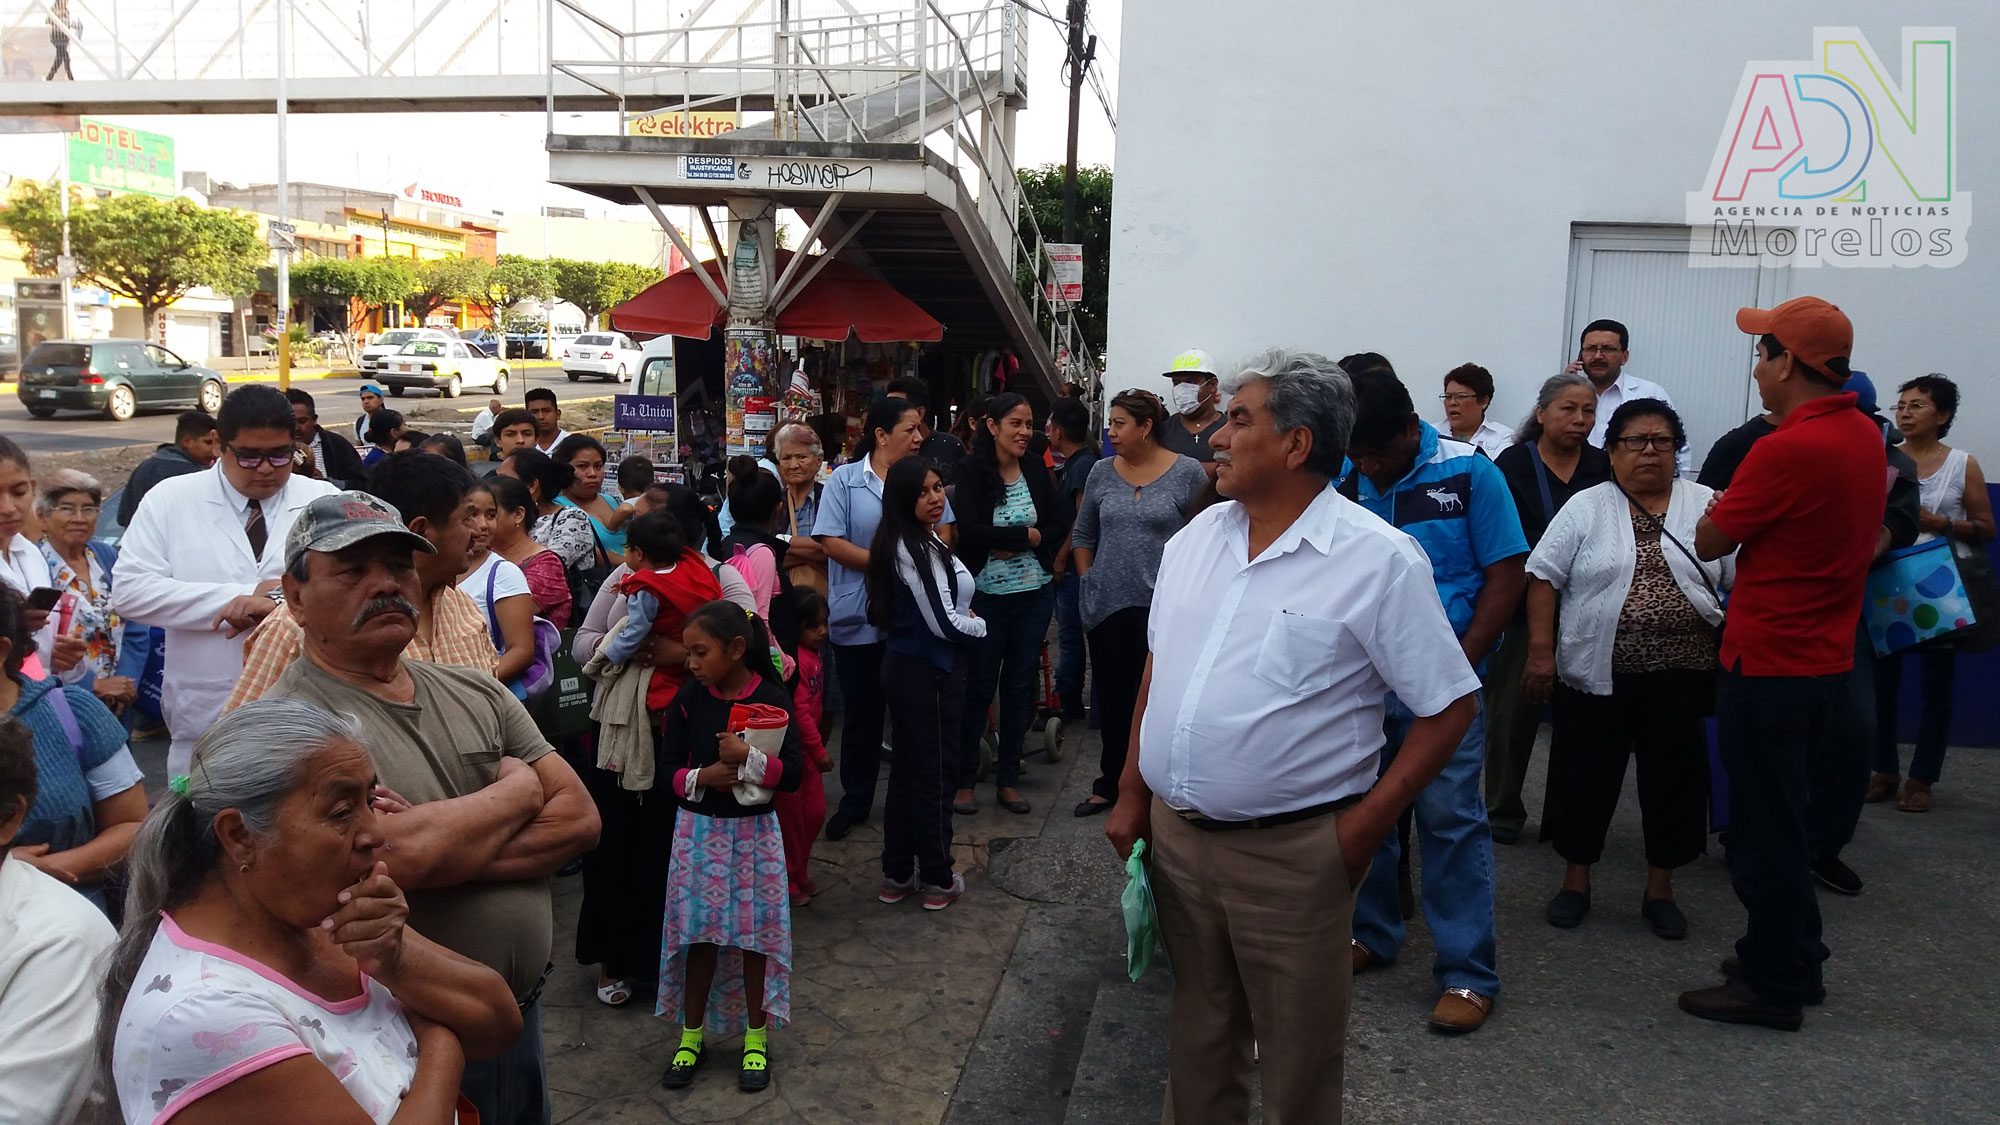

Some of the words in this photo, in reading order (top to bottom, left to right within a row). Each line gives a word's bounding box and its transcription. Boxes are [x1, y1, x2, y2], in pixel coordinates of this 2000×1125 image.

[660, 115, 735, 136] elektra
[688, 157, 733, 165] DESPIDOS
[421, 189, 463, 207] HONDA
[268, 219, 296, 234] VENDO
[621, 403, 635, 417] La
[639, 403, 673, 418] Unión
